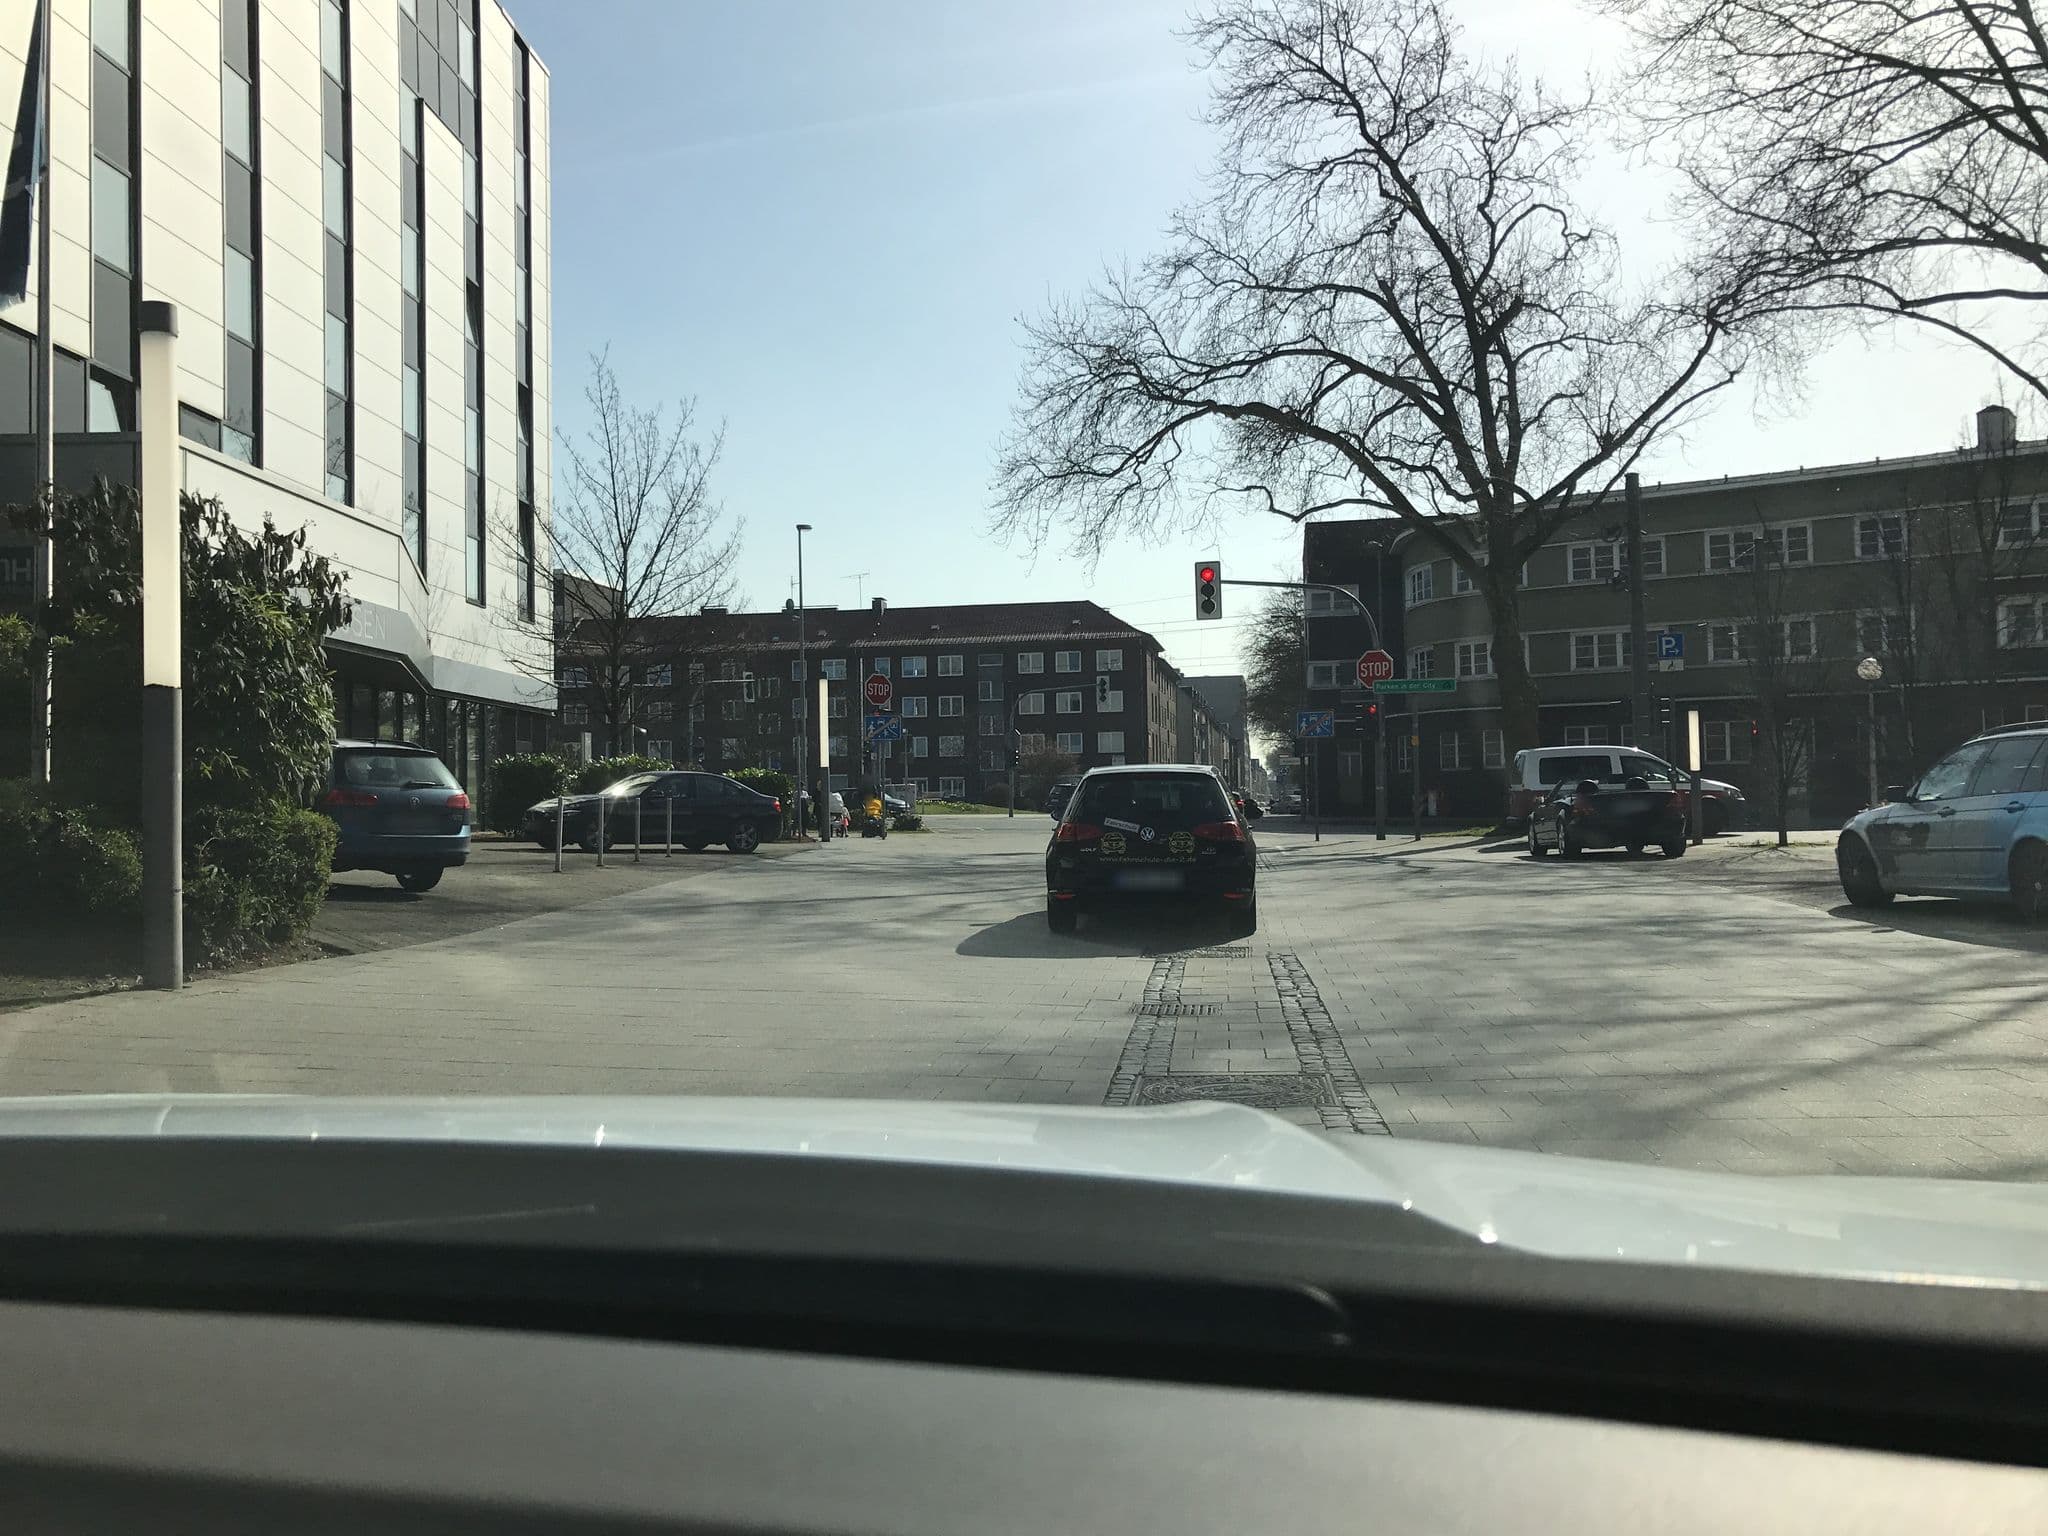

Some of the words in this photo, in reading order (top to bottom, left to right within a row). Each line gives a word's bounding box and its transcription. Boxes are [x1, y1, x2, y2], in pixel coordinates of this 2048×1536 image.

[1662, 637, 1676, 656] P
[1360, 662, 1390, 678] STOP
[867, 683, 890, 696] STOP
[1422, 681, 1436, 690] City
